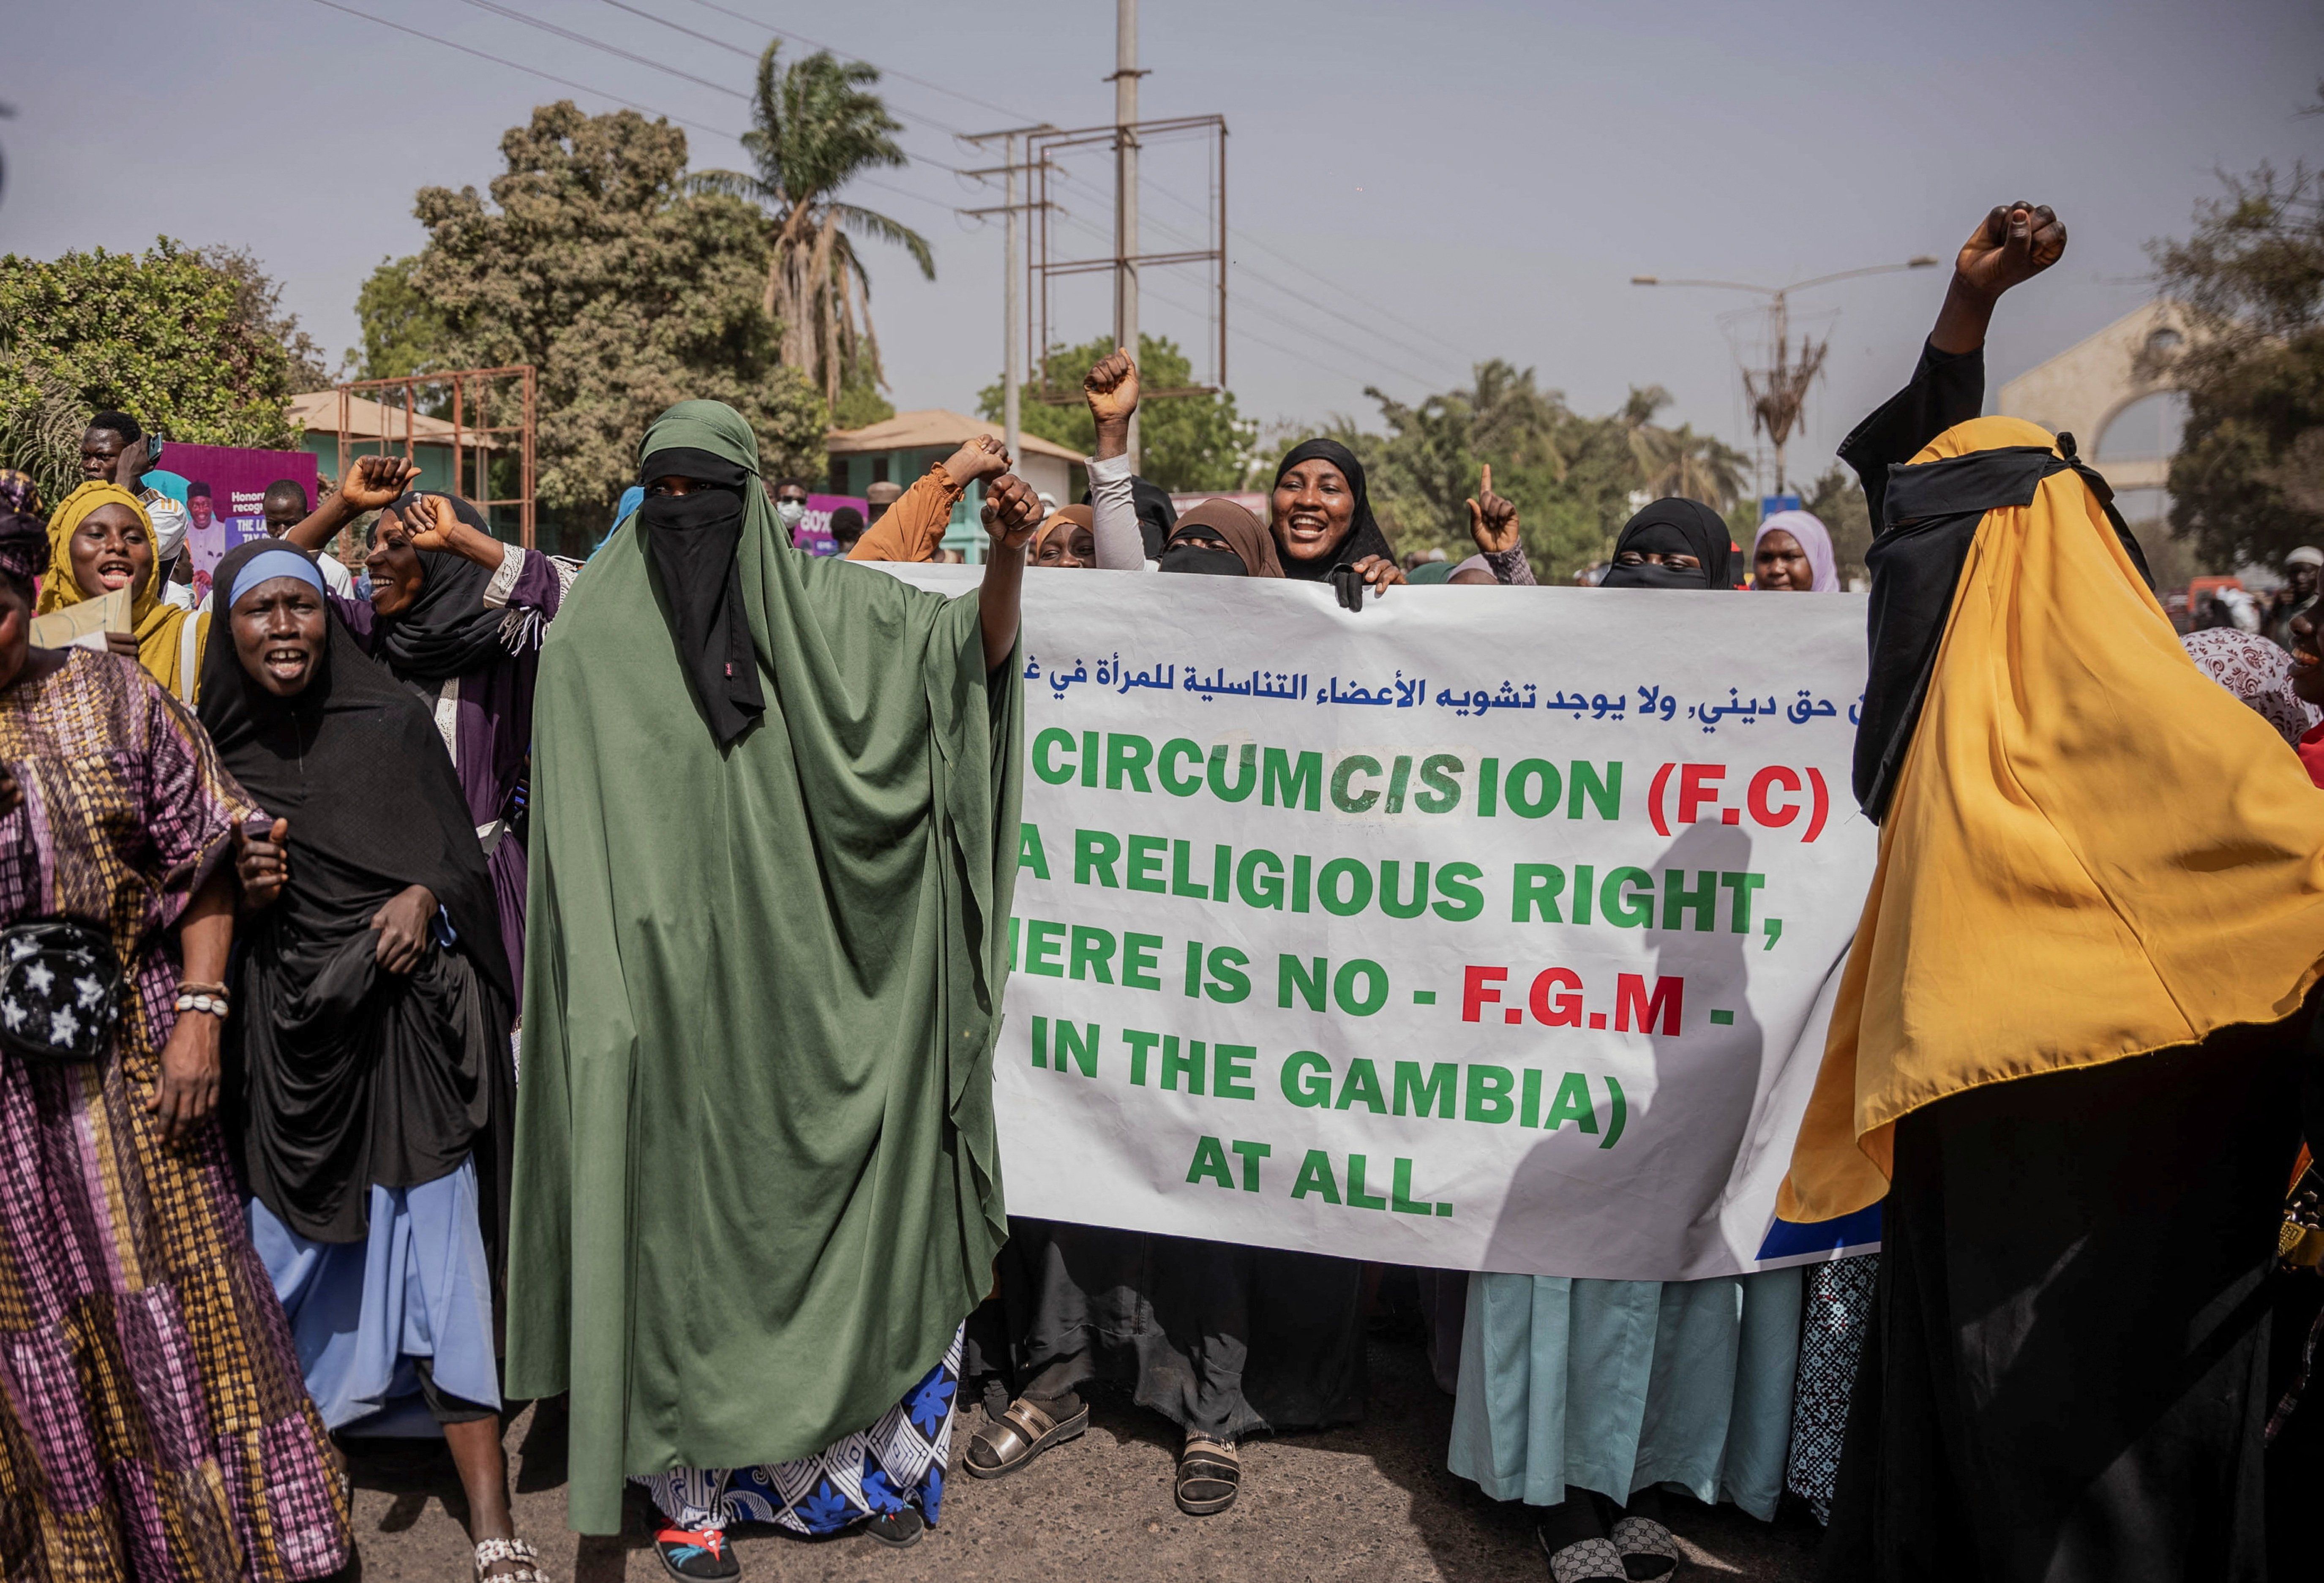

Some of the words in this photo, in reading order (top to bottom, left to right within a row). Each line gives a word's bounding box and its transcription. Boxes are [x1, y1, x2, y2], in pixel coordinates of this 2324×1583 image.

[236, 519, 254, 531] THE
[1050, 658, 1087, 700] في
[1097, 652, 1174, 695] للمرأة
[1184, 666, 1307, 702] التناسلية
[1316, 670, 1425, 708] الأعضاء
[1436, 680, 1536, 717] تشويه
[1547, 691, 1626, 720] يوجد
[1638, 685, 1676, 721] ولا
[1787, 690, 1836, 724] حق
[1032, 727, 1623, 820] CIRCUMCISION
[1648, 763, 1829, 844] (F.C)
[1016, 823, 1051, 880] A
[1074, 828, 1484, 922] RELIGIOUS
[1511, 863, 1782, 951] RIGHT,
[1184, 940, 1251, 1004] IS
[1278, 954, 1389, 1017] NO
[1413, 991, 1436, 1005] -
[1461, 965, 1684, 1037] F.G.M
[1710, 1010, 1734, 1025] -
[1031, 1016, 1100, 1078] IN
[1122, 1029, 1257, 1101] THE
[1280, 1050, 1627, 1150] GAMBIA)
[1186, 1136, 1271, 1193] AT
[1290, 1149, 1453, 1218] ALL.
